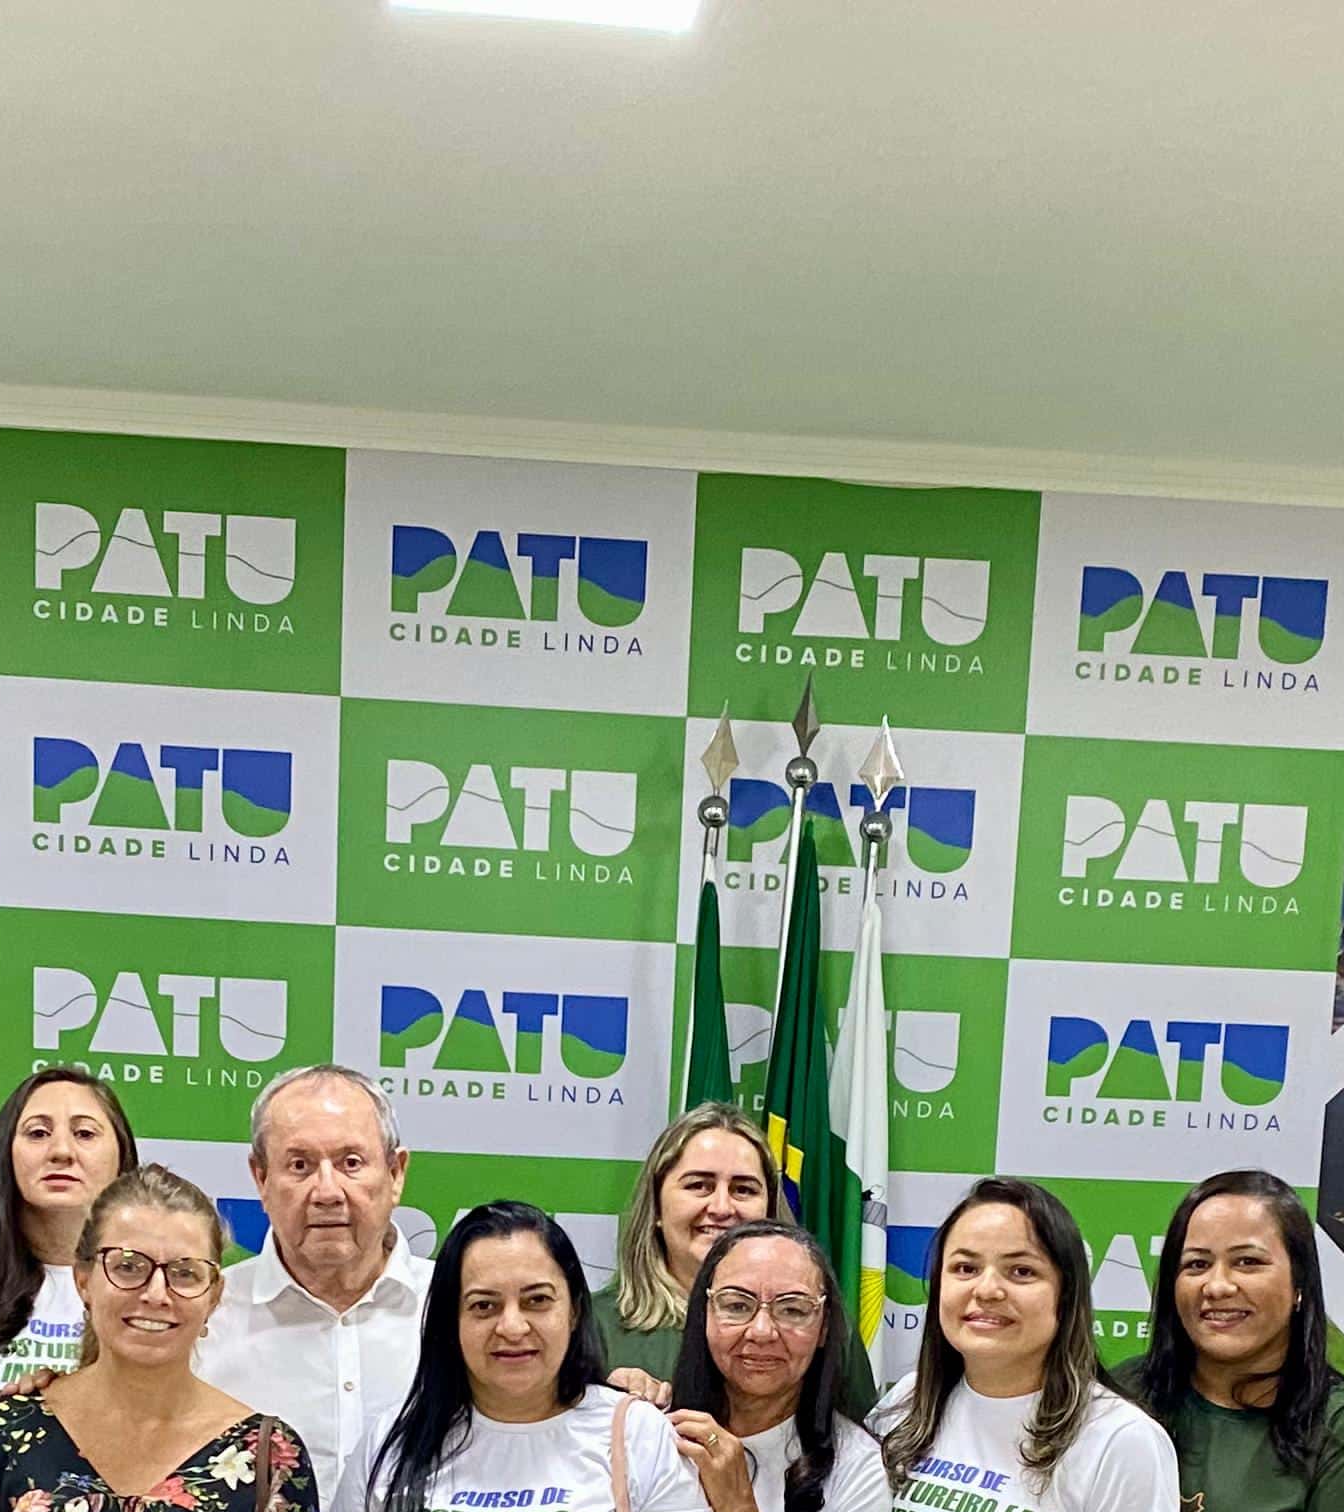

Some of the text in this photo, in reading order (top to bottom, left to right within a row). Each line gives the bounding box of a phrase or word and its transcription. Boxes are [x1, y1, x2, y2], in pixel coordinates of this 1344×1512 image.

[34, 501, 296, 605] PATU
[391, 525, 648, 628] PATU
[738, 547, 991, 647] PATU
[33, 600, 295, 634] CIDADE LINDA
[1078, 566, 1329, 665] PATU
[389, 623, 644, 657] CIDADE LINDA
[735, 642, 985, 675] CIDADE LINDA
[1074, 661, 1320, 693] CIDADE LINDA
[33, 737, 292, 838] PATU
[386, 759, 637, 858] PATU
[727, 778, 977, 874] PATU
[1061, 795, 1308, 890] PATU
[32, 832, 290, 866] CIDADE LINDA
[384, 853, 634, 885] CIDADE LINDA
[725, 871, 851, 895] CIDDE
[1059, 887, 1301, 917] CIDADE LINDA
[33, 967, 288, 1063] PATU
[380, 985, 629, 1080] PATU
[31, 1059, 262, 1089] CADE LIND
[1046, 1015, 1290, 1106] PATU
[379, 1077, 625, 1106] CIDADE LINDA
[892, 1099, 955, 1120] NDA
[1043, 1105, 1282, 1133] CIDADE LINDA
[29, 1318, 86, 1338] CURS
[450, 1487, 574, 1508] CURSO DE
[979, 1470, 1011, 1493] DE
